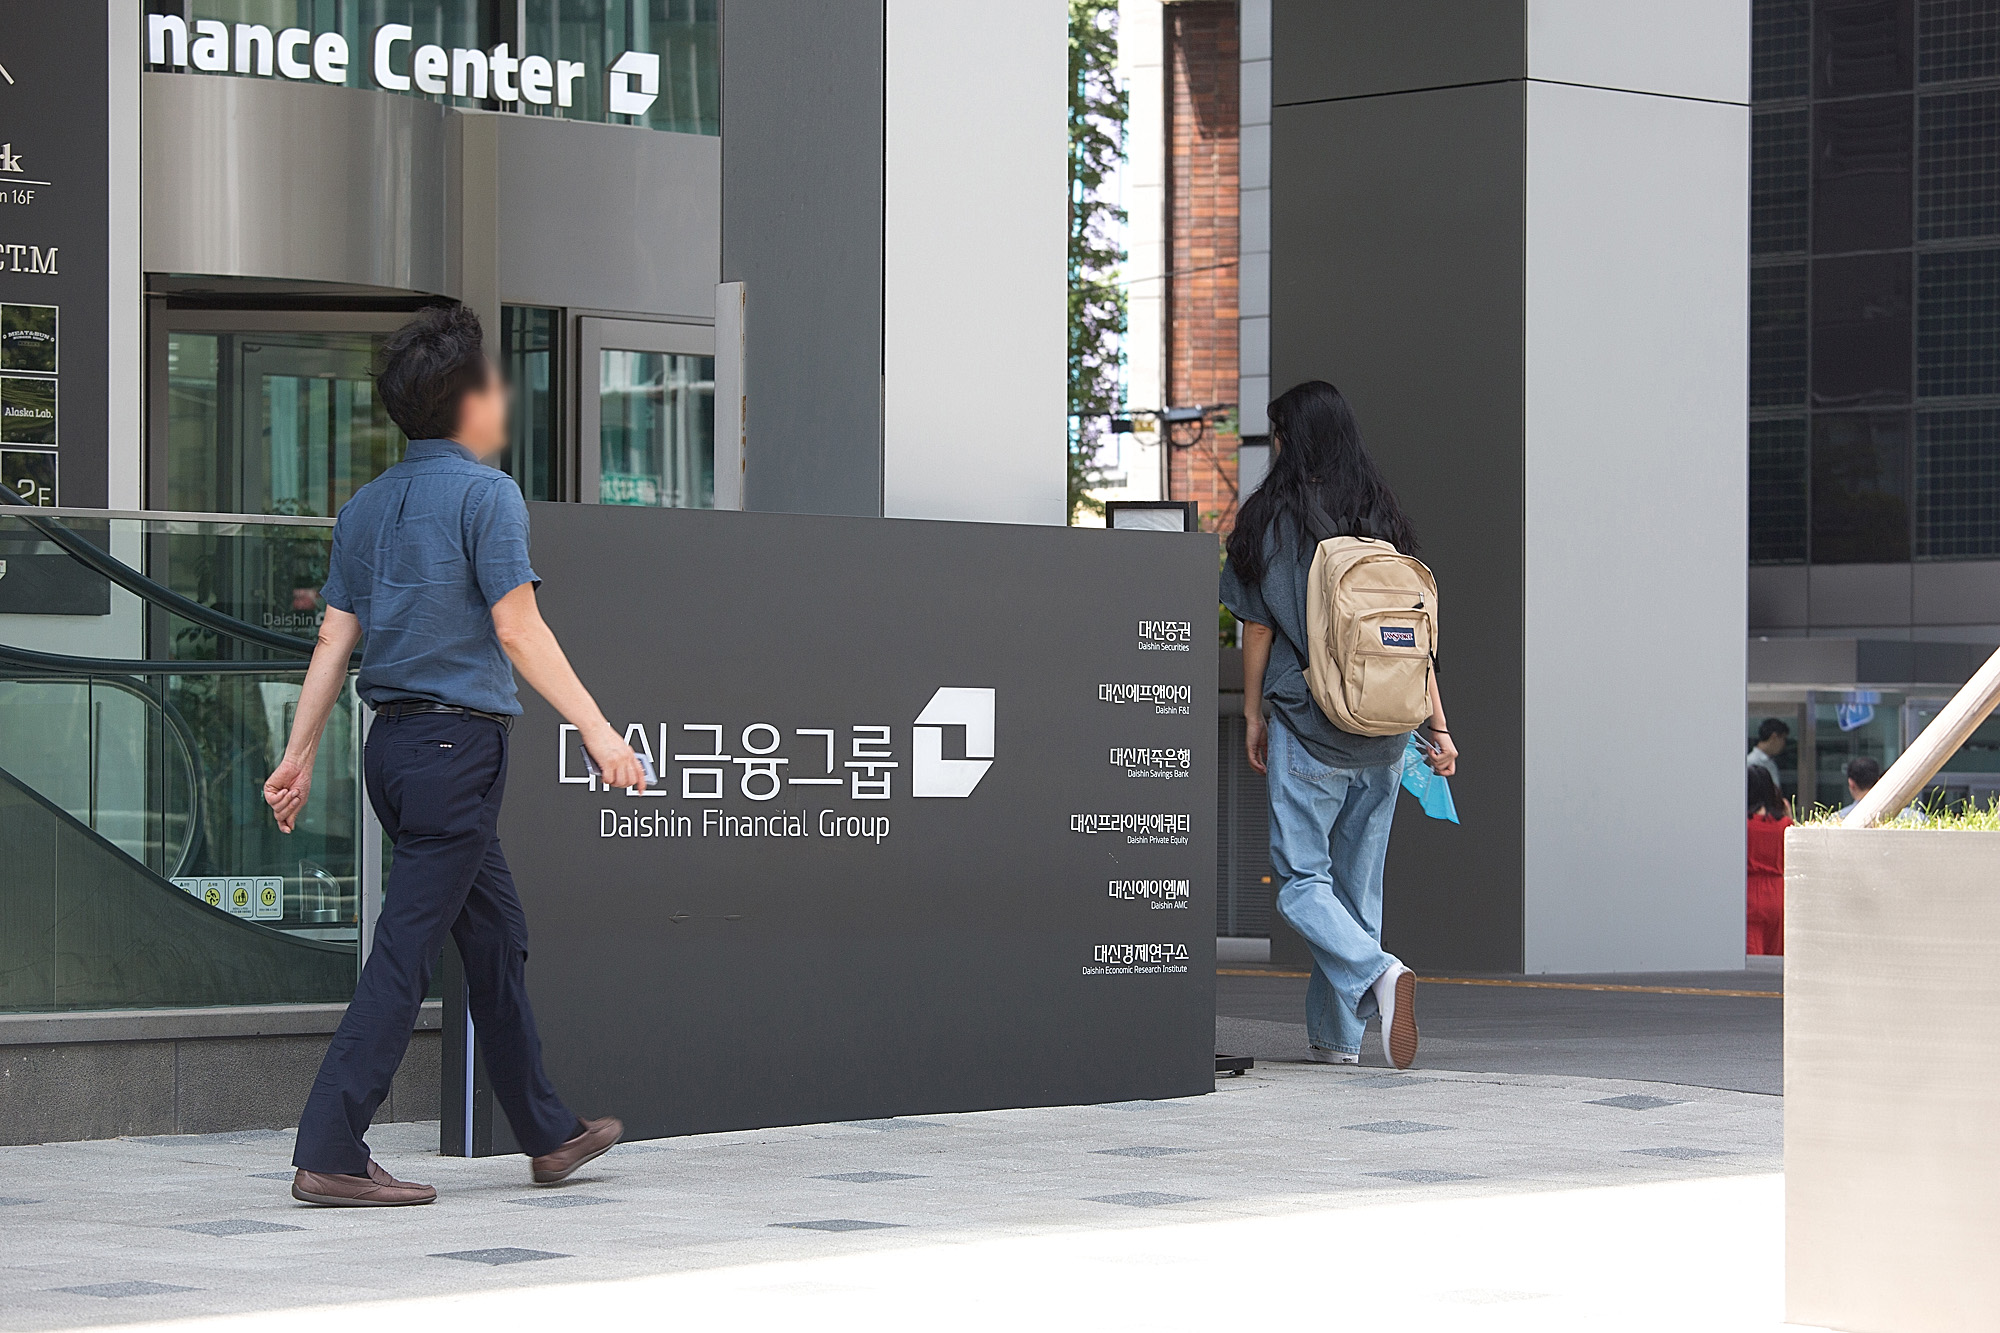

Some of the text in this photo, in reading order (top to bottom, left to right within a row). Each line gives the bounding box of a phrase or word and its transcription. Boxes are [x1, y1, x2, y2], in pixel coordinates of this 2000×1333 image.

[148, 13, 585, 107] nance Center
[12, 189, 35, 205] 16F
[5, 407, 54, 419] Alaska Lab.
[263, 612, 314, 626] Daishin
[1138, 620, 1191, 641] 대신증권
[1138, 641, 1190, 652] Daishin Securities
[1098, 683, 1191, 705] 대신에프앤아이
[1155, 705, 1177, 715] Daishin
[1127, 769, 1190, 780] Daishin Savings Bank
[600, 808, 890, 845] Daishin Financial Group
[1070, 813, 1190, 835] 대신프라이빗에쿼티
[1127, 835, 1189, 846] Daishin Private Equity
[1108, 879, 1190, 900] 대신에이엠씨
[1151, 900, 1189, 910] Daishin AMC
[1094, 943, 1190, 964] 대신경제연구소
[1082, 963, 1188, 975] Daishin Economic Research Institute
